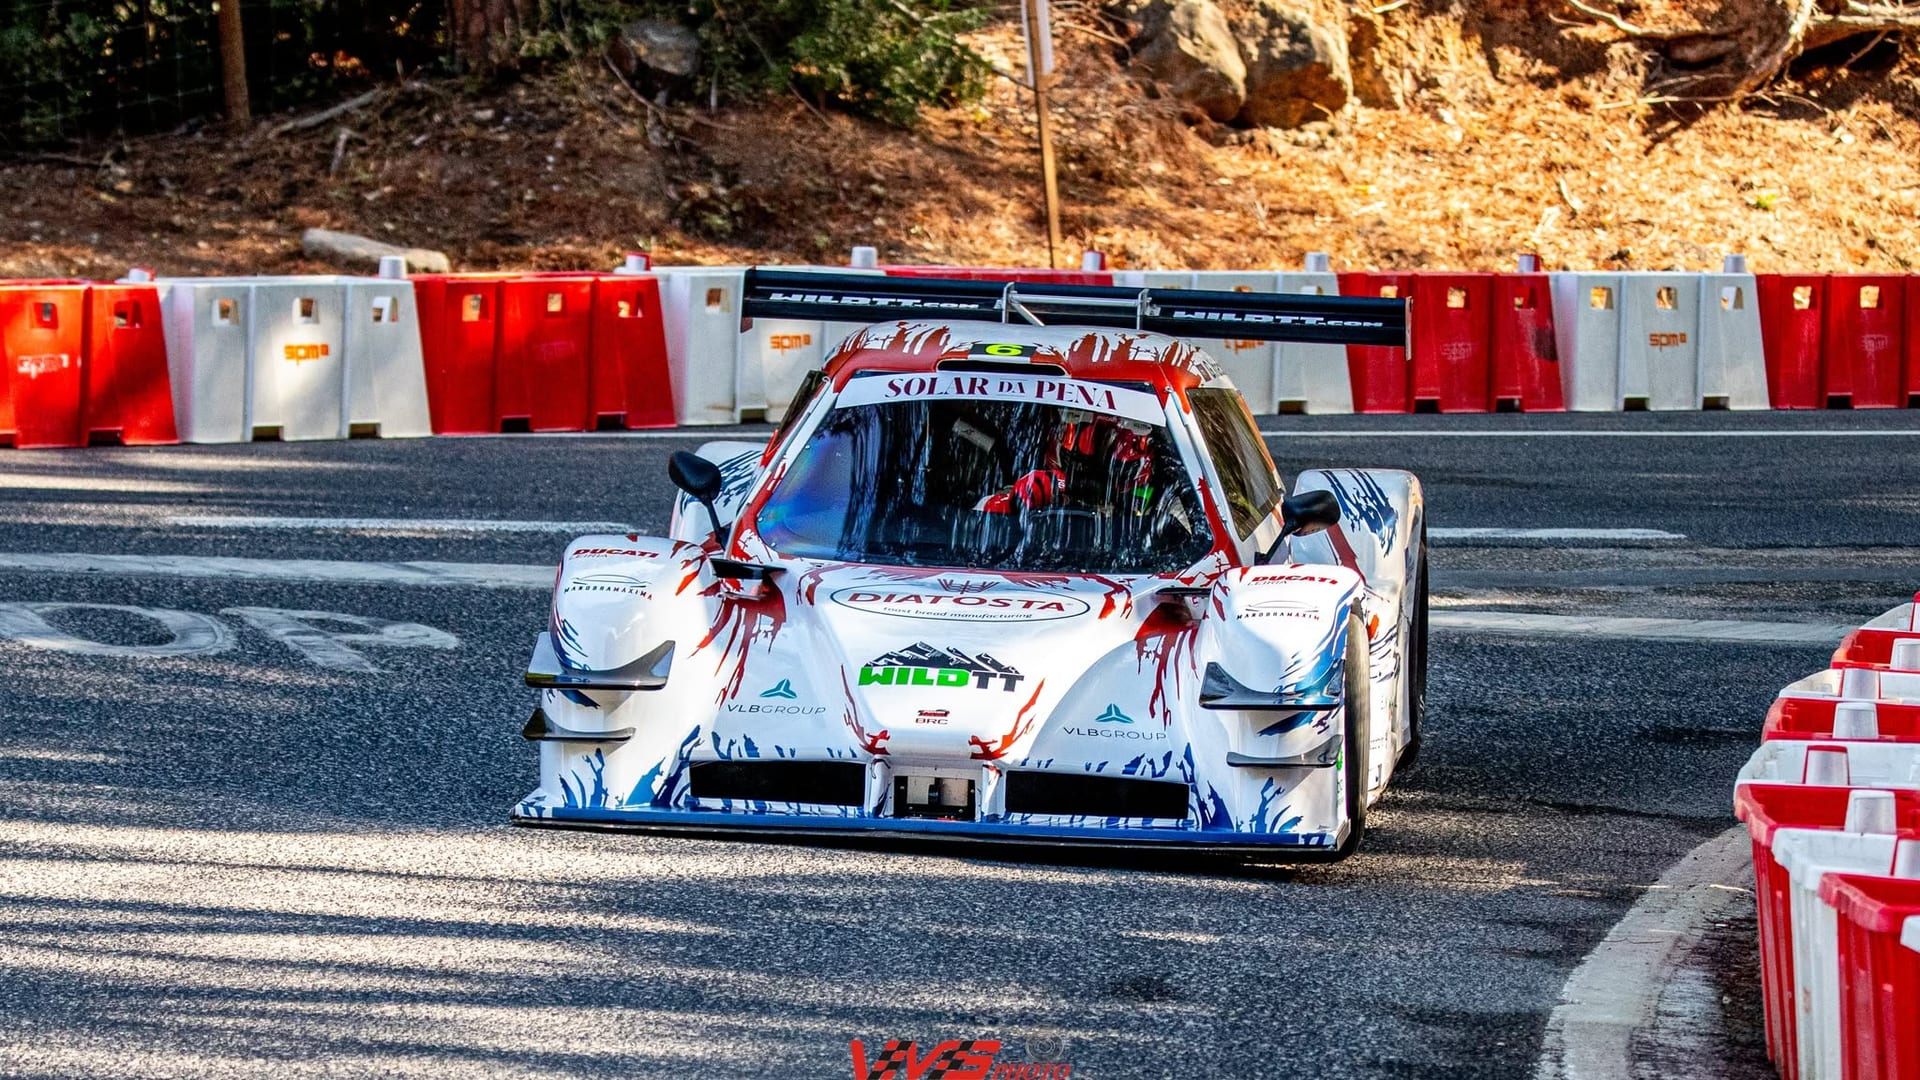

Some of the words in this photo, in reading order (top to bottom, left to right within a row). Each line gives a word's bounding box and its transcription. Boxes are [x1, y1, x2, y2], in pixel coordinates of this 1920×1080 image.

[985, 343, 1025, 357] 6
[884, 376, 989, 398] SOLAR
[998, 380, 1025, 394] DA
[1035, 380, 1117, 410] PENA
[572, 548, 660, 559] DUCATI
[1251, 575, 1339, 585] DUCATI
[847, 592, 1066, 612] DIATOSTA
[950, 612, 1033, 620] manufacturing
[857, 666, 1025, 692] WILDTT
[727, 703, 827, 715] VLBGROUP
[915, 717, 949, 725] BRC
[1063, 726, 1168, 741] VLBGROUP
